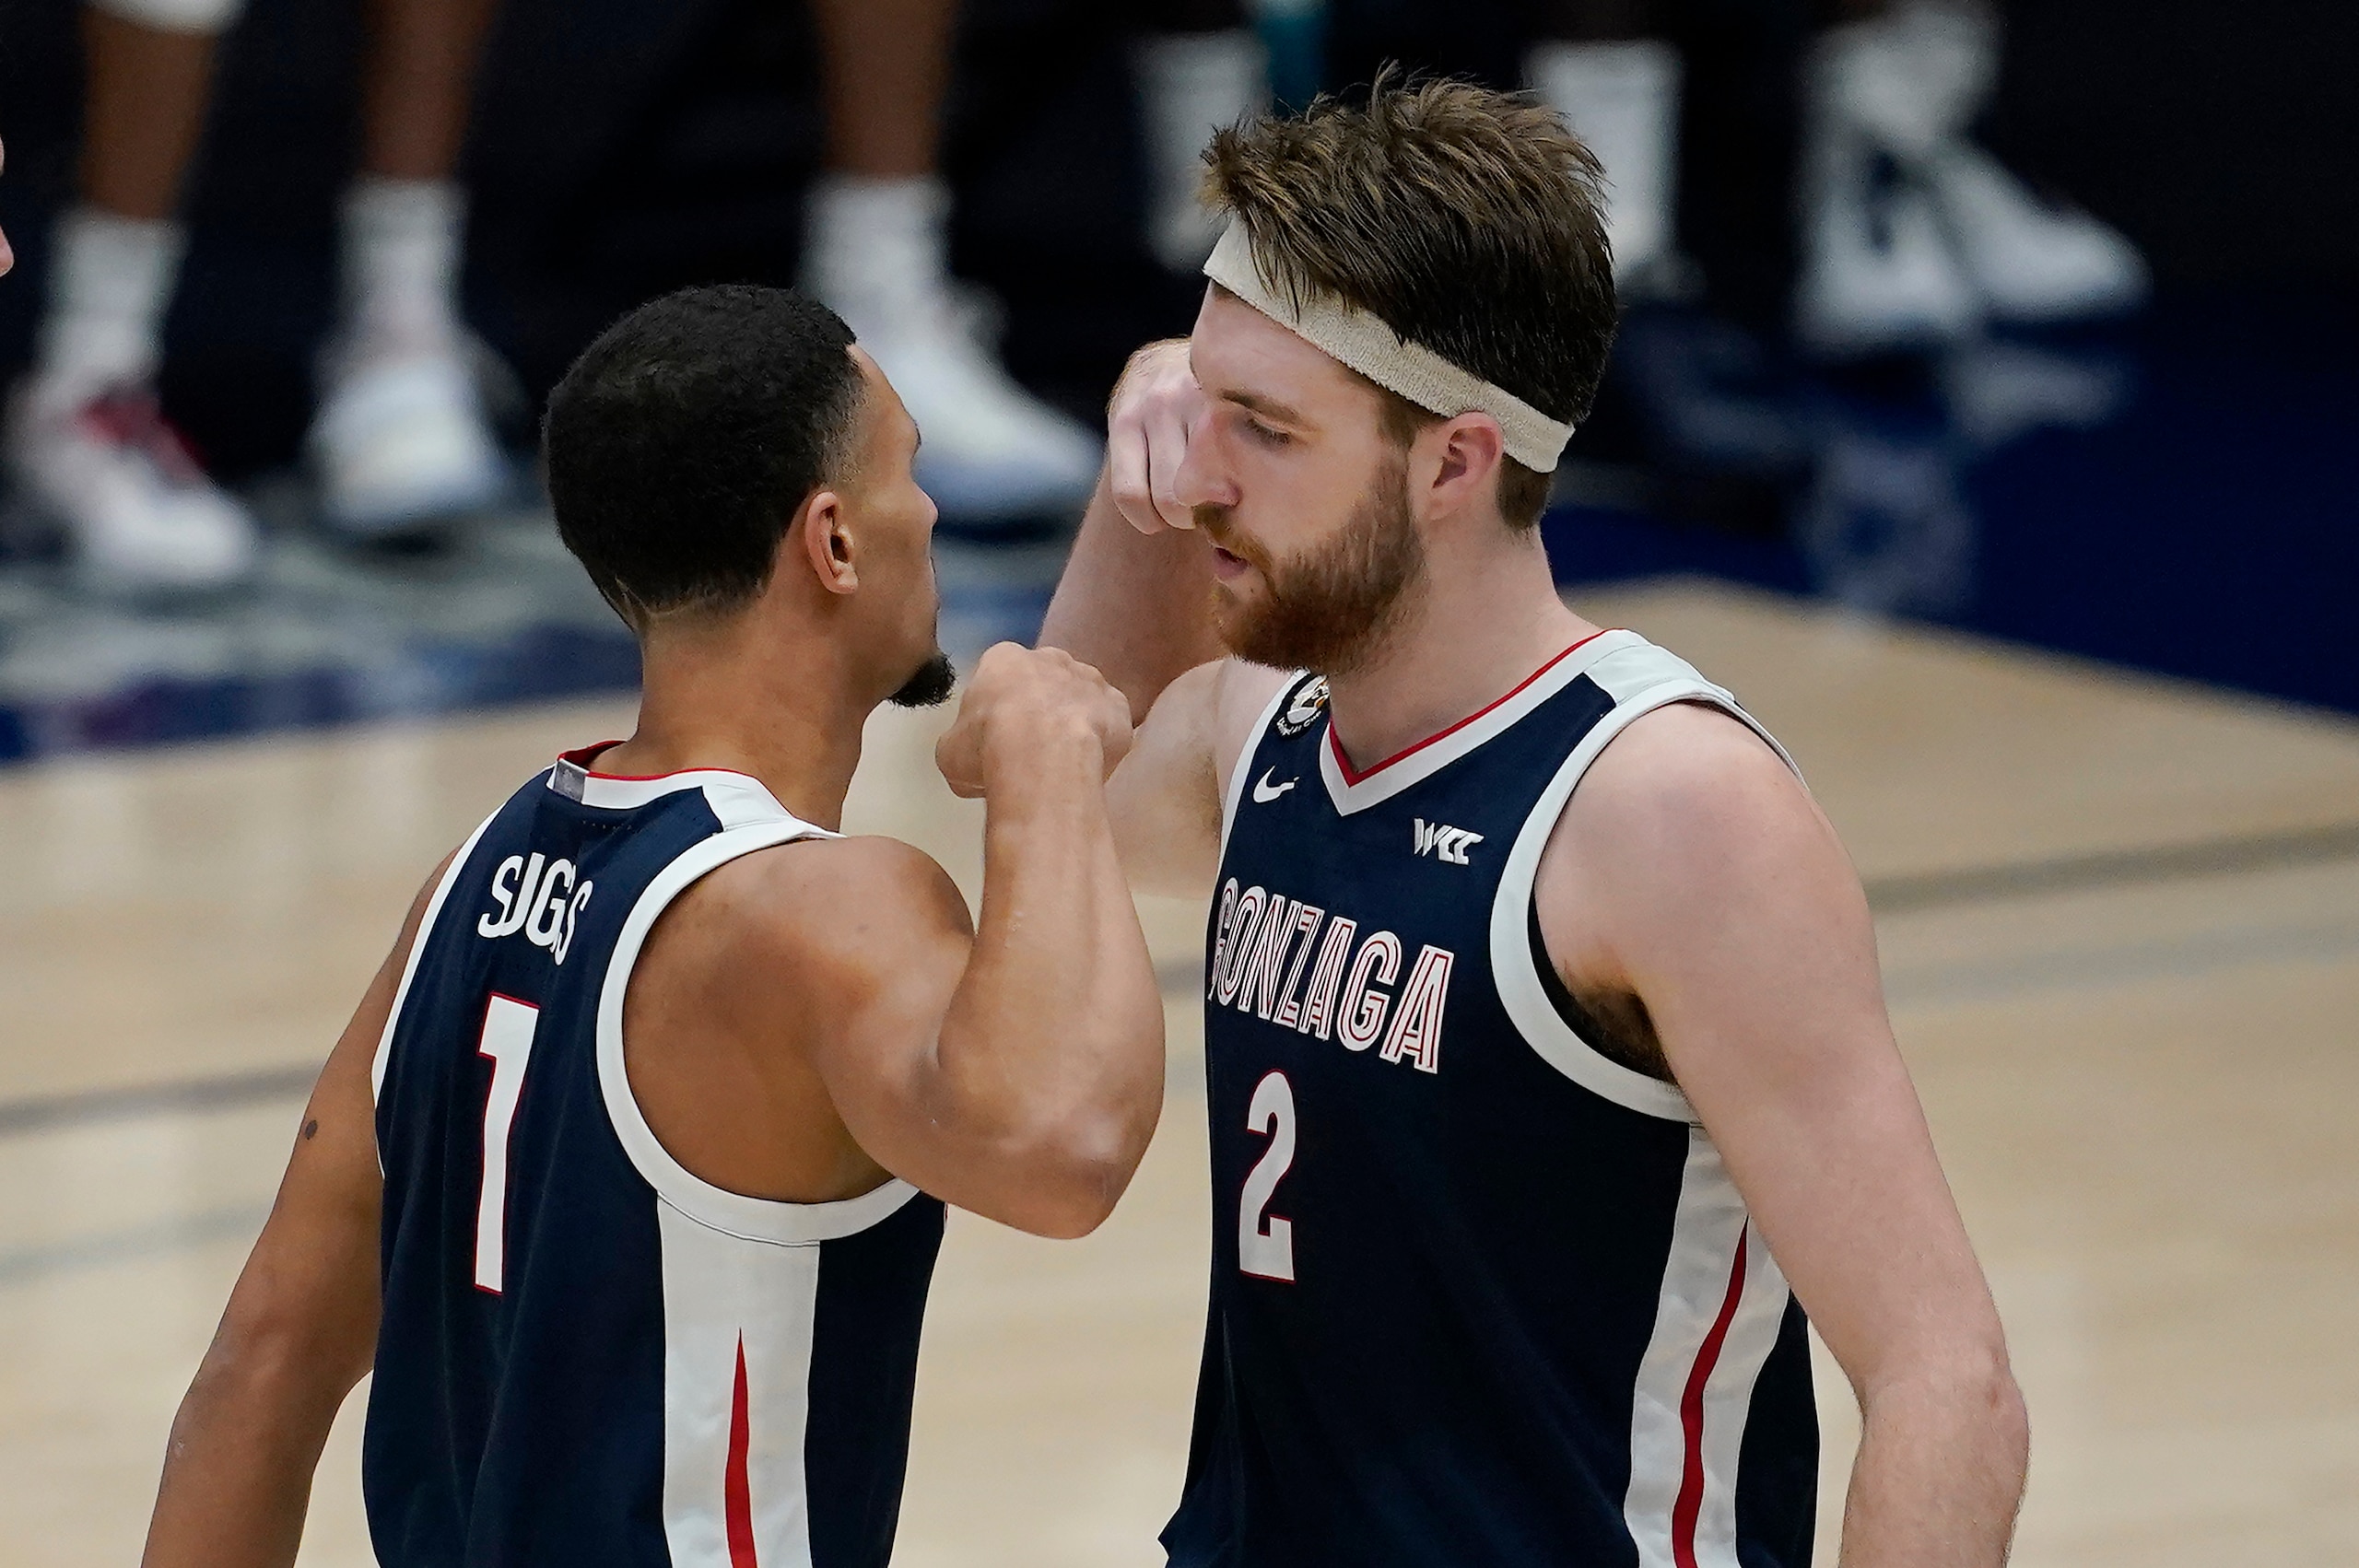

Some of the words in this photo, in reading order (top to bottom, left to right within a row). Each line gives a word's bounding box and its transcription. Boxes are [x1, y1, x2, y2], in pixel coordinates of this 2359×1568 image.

[1414, 818, 1485, 865] WCC
[1208, 877, 1455, 1074] GONZAGA
[474, 991, 540, 1295] 1
[1238, 1069, 1296, 1283] 2
